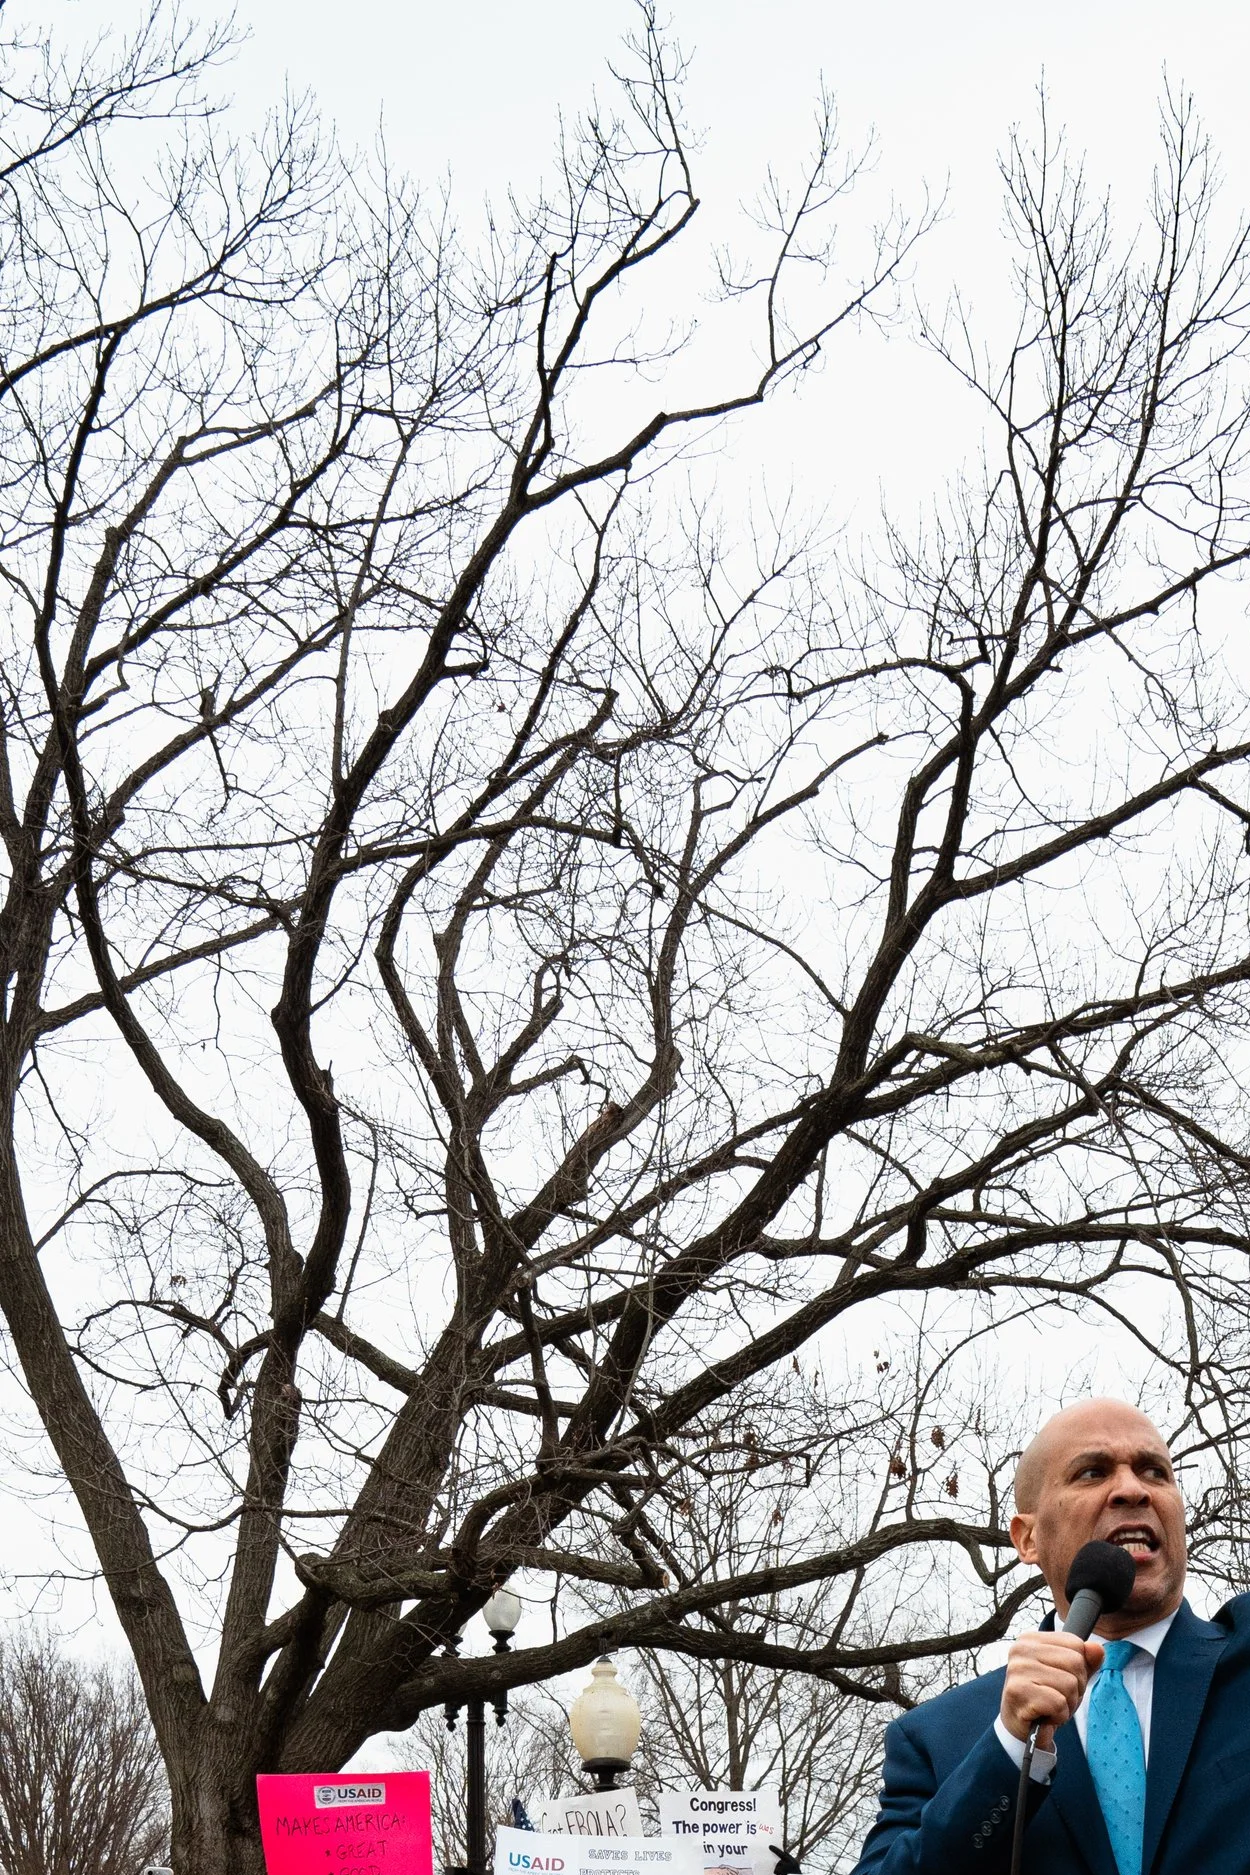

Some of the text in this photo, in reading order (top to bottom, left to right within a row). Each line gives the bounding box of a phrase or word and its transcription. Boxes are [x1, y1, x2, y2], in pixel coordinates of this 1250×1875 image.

[337, 1788, 382, 1799] USAID
[690, 1797, 757, 1814] Congress!
[276, 1812, 406, 1836] MAKES AMERICA:
[672, 1820, 700, 1834] The
[702, 1822, 742, 1836] power
[746, 1820, 757, 1834] is
[337, 1839, 387, 1860] GREAT
[588, 1849, 673, 1862] SAVES LIVES
[703, 1841, 748, 1858] in your
[509, 1851, 565, 1871] USAID
